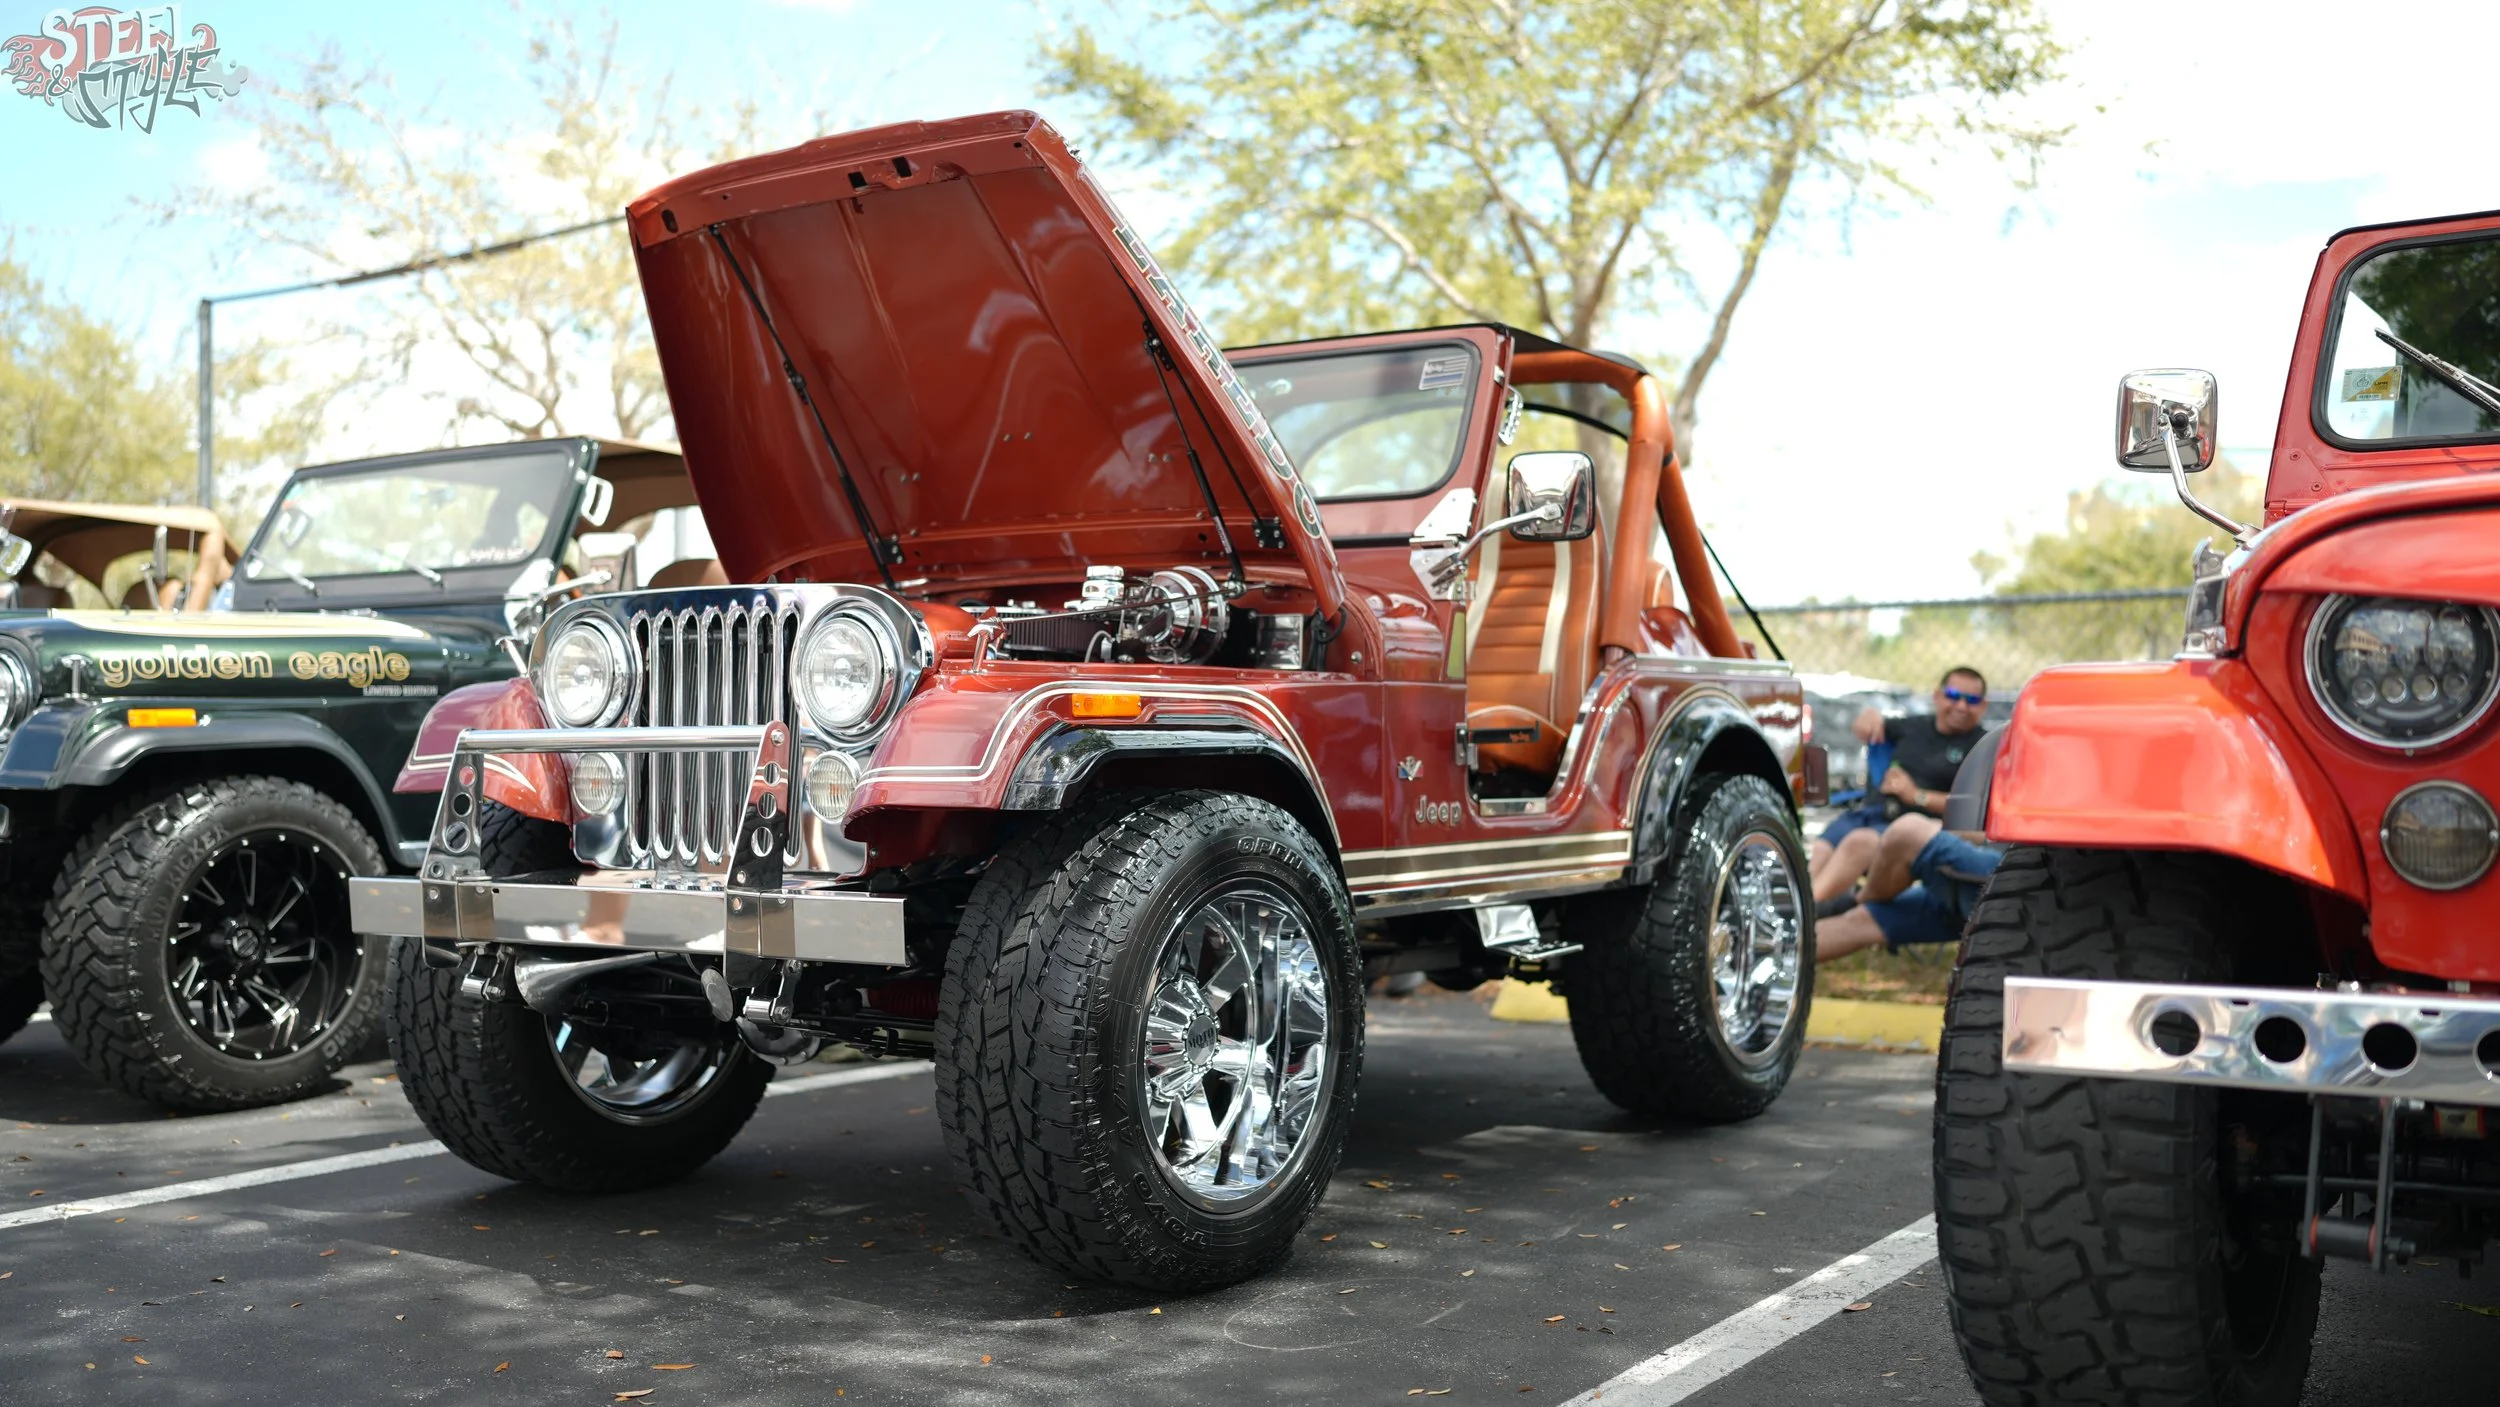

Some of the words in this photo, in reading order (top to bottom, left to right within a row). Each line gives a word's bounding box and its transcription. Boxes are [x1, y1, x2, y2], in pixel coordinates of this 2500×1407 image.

[100, 644, 272, 689] golden
[289, 645, 411, 689] eagle
[1416, 794, 1462, 828] Jeep
[1237, 835, 1304, 870] OPEN
[1132, 1171, 1207, 1246] TOYO
